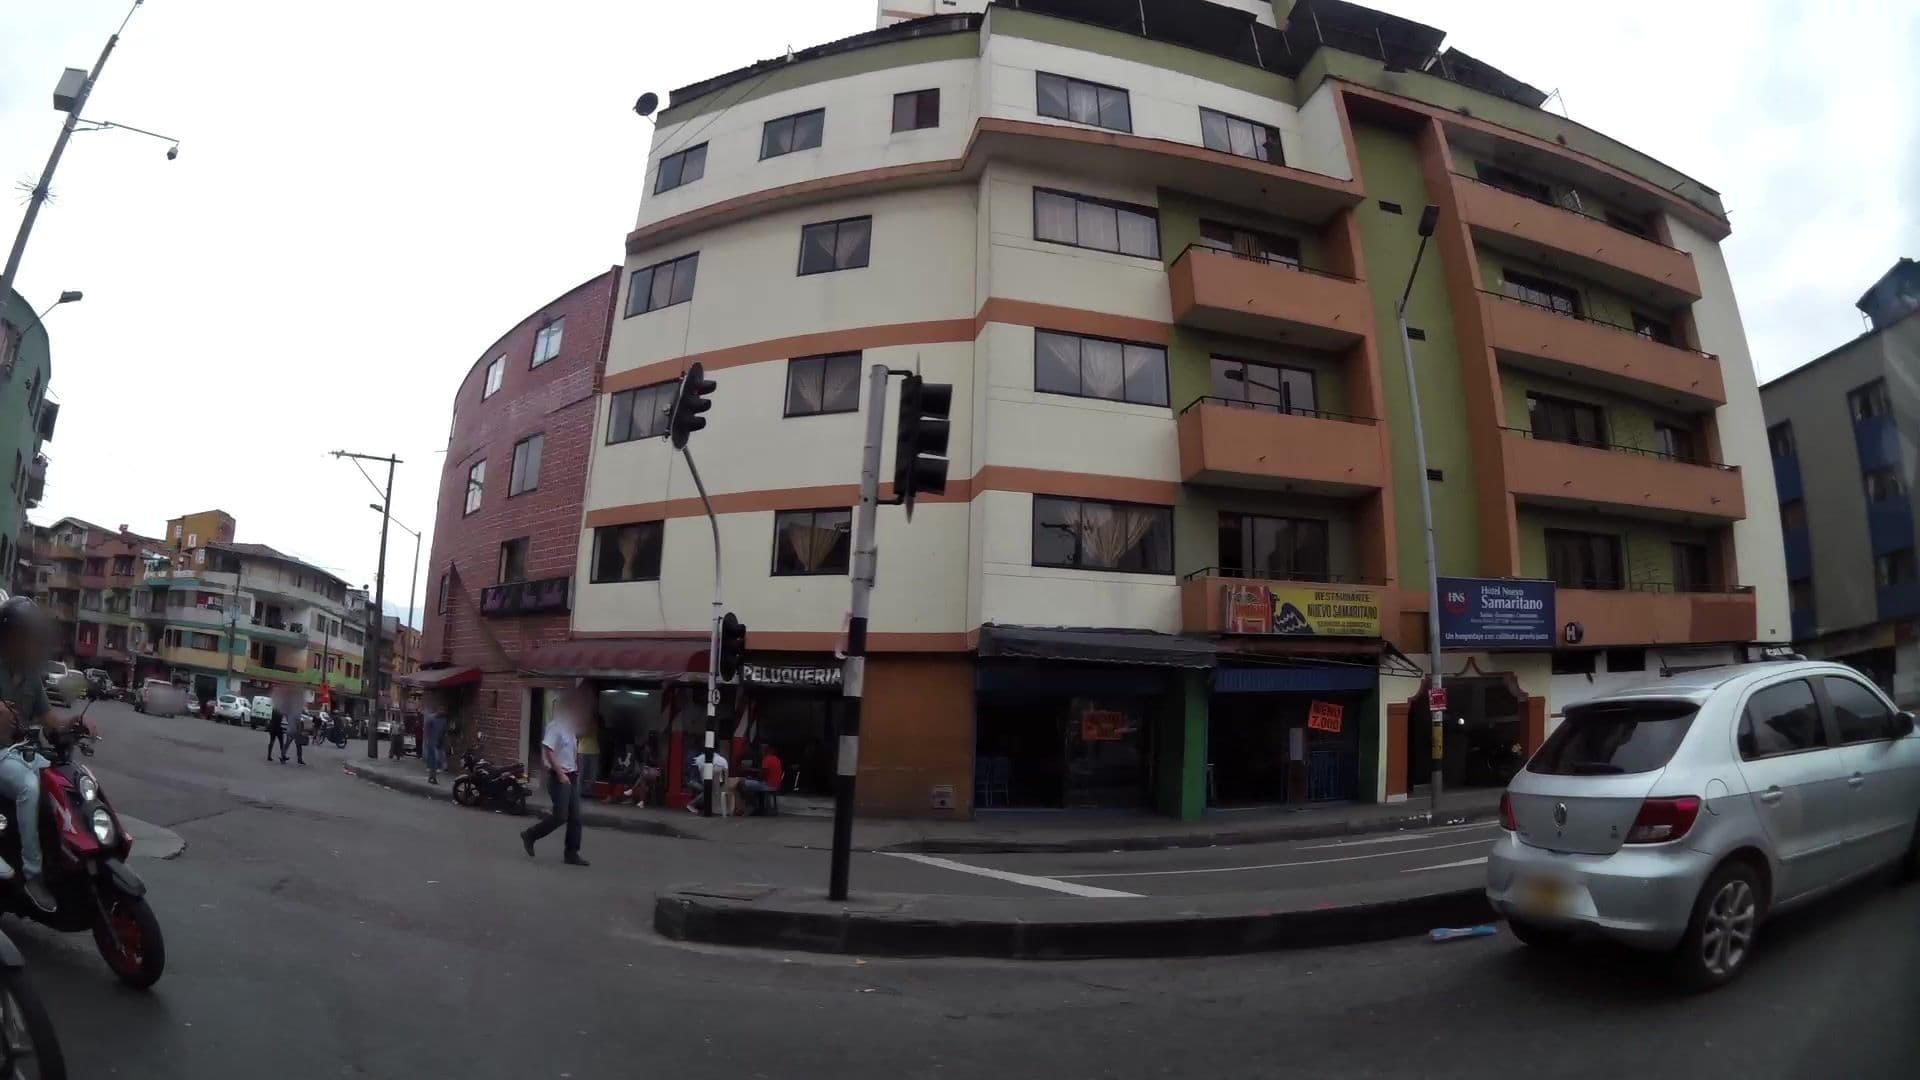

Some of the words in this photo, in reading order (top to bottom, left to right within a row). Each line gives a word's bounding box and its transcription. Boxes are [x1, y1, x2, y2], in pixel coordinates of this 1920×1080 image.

[1315, 591, 1369, 603] RESTAURANTE
[1448, 592, 1465, 603] HNS
[1481, 586, 1500, 595] Hotel
[1502, 587, 1524, 597] Nuevo
[1481, 595, 1543, 610] Samaritano
[1307, 603, 1332, 618] NUEVO
[1333, 604, 1378, 620] SAMARITANO
[744, 664, 841, 684] PELUQUERIA
[1311, 715, 1339, 730] 7.000
